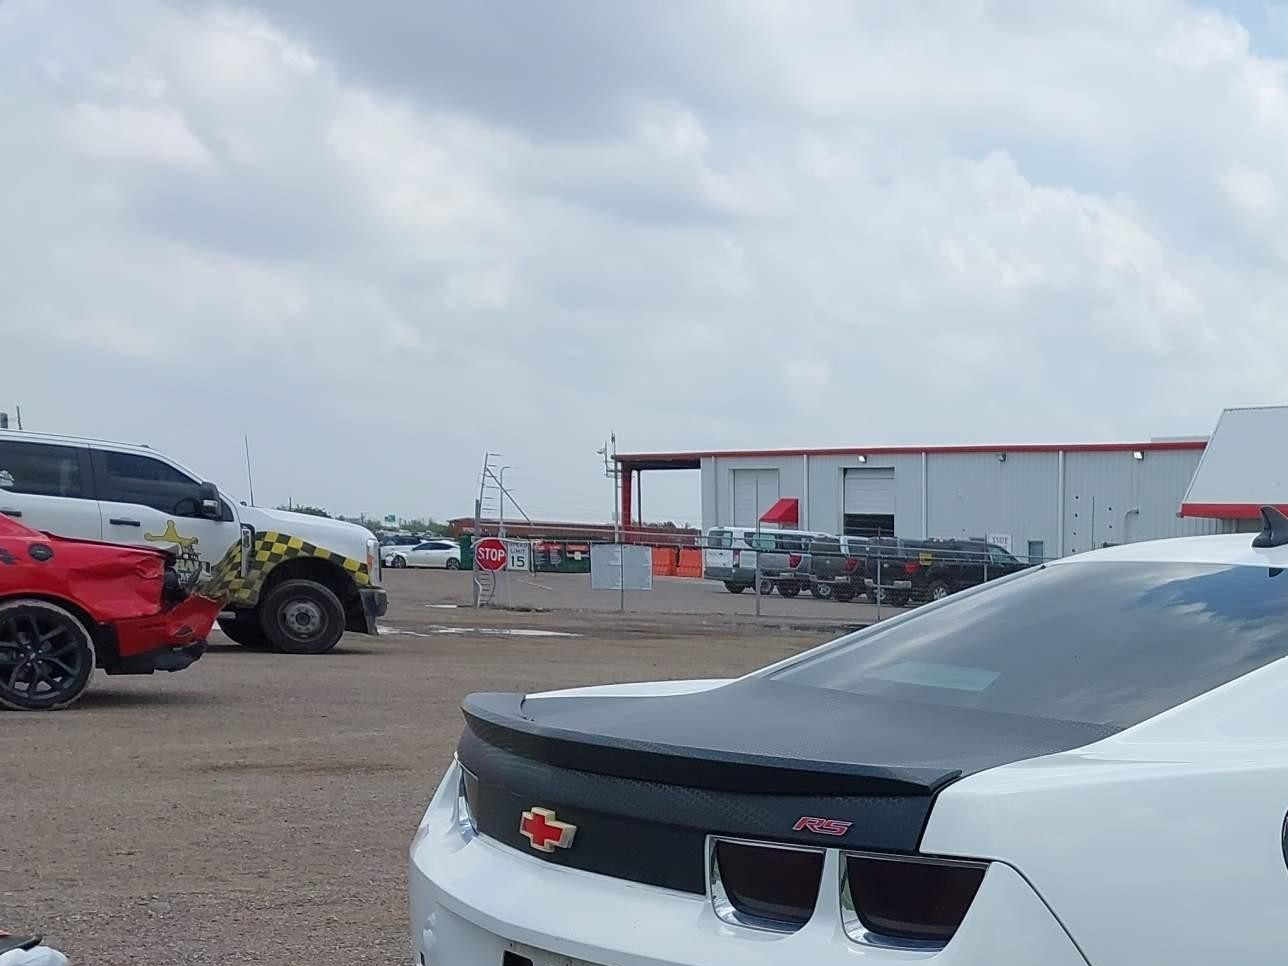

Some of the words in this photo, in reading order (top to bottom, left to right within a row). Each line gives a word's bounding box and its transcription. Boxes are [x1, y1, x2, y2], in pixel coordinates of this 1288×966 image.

[478, 547, 505, 561] STOP
[511, 555, 525, 568] 15
[792, 816, 853, 836] RS
